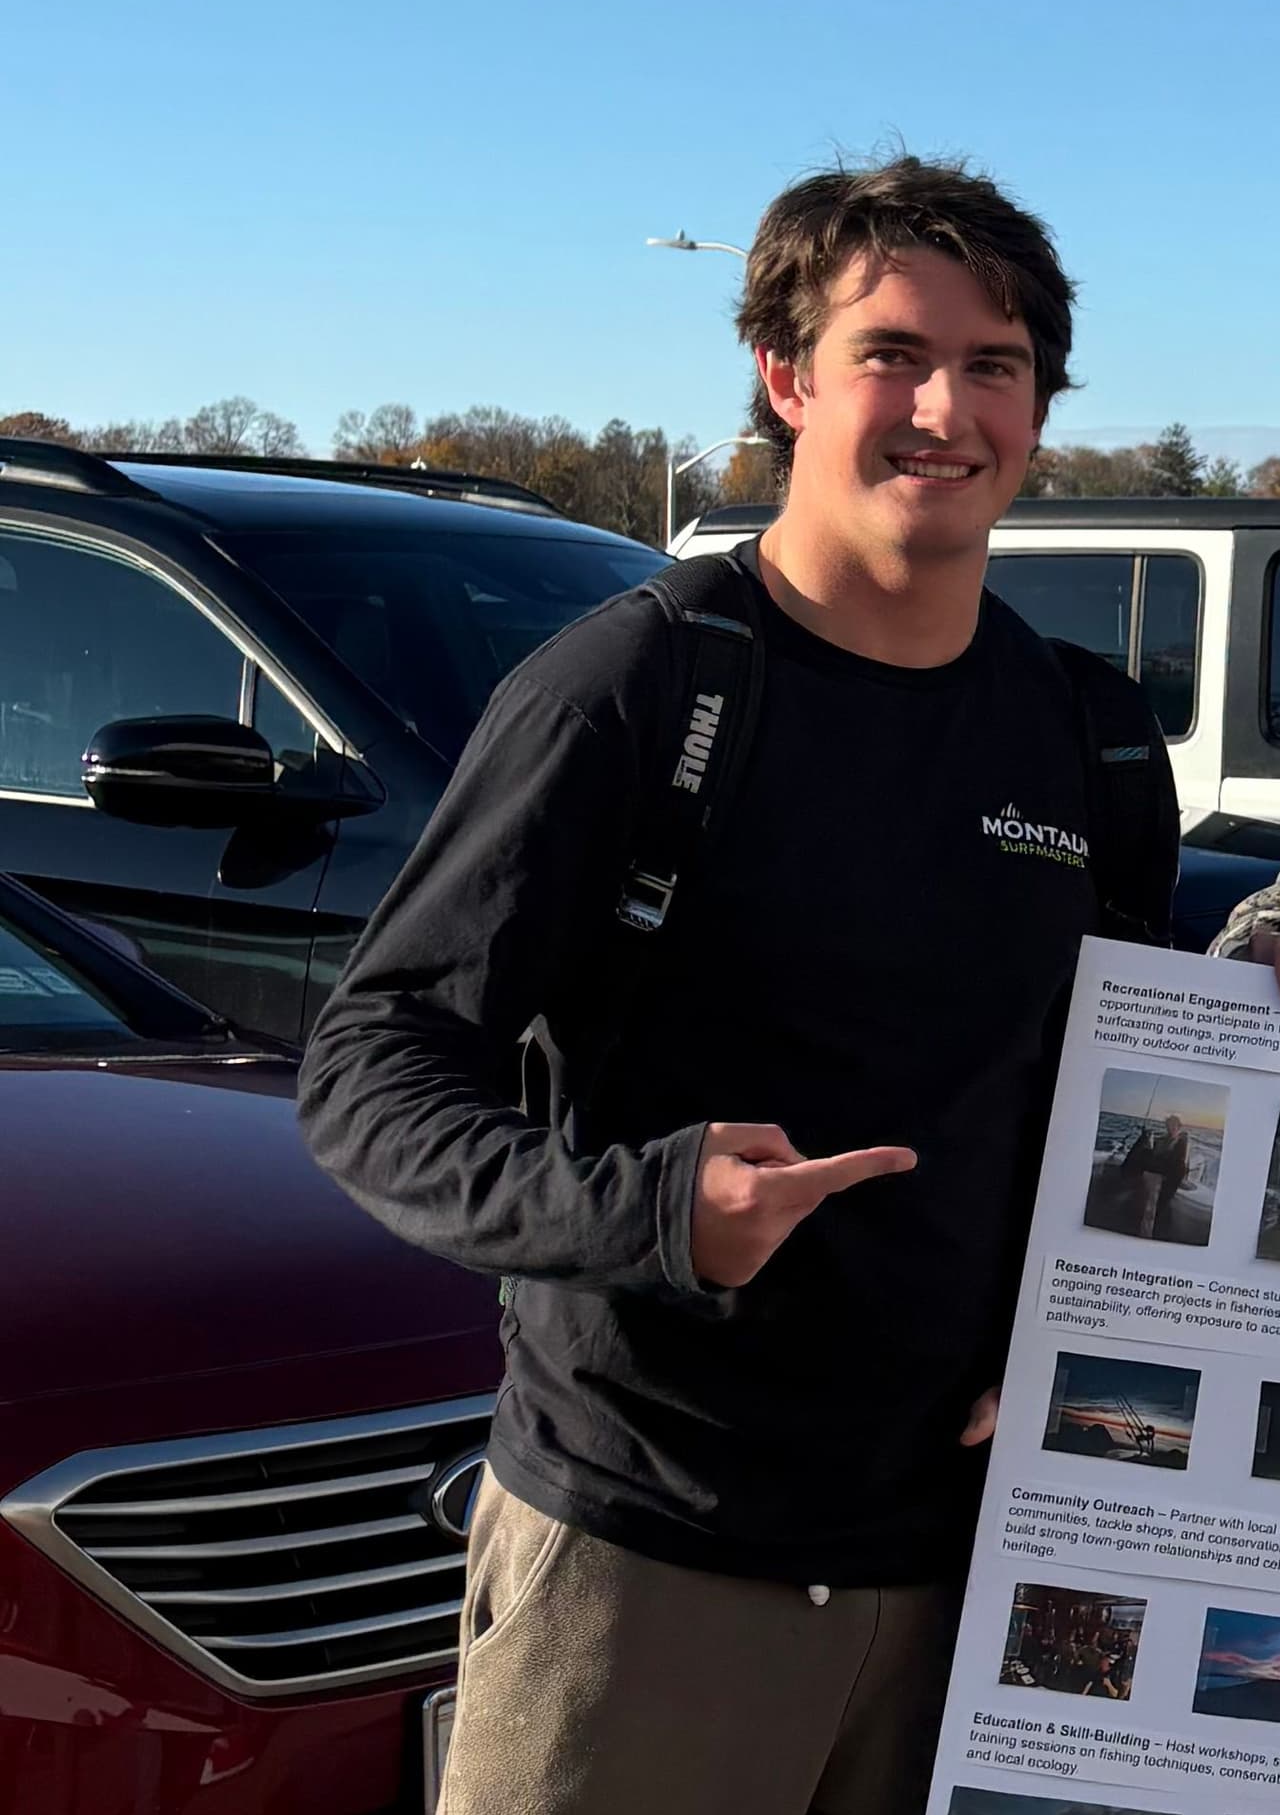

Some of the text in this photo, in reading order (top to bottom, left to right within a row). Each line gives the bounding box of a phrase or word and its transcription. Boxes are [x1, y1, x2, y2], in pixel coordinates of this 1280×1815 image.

[672, 693, 724, 794] THULE
[1102, 980, 1185, 1003] Recreational
[1188, 992, 1270, 1015] Engagement
[1051, 1277, 1102, 1296] ongoing
[1105, 1285, 1160, 1302] research
[1162, 1293, 1212, 1308] projects
[1215, 1298, 1227, 1310] in
[1054, 1258, 1118, 1279] Research
[1121, 1267, 1193, 1289] Integration
[1208, 1280, 1260, 1299] Connect
[1046, 1310, 1108, 1329] pathways.
[1049, 1294, 1131, 1317] sustainability,
[1135, 1304, 1182, 1324] offering
[1185, 1313, 1243, 1330] exposure
[1245, 1320, 1258, 1332] to
[1008, 1506, 1091, 1528] communities,
[1095, 1516, 1133, 1532] tackle
[1133, 1521, 1176, 1540] shops,
[1180, 1529, 1205, 1542] and
[1011, 1487, 1090, 1511] Community
[1092, 1498, 1155, 1518] Outreach
[1169, 1508, 1216, 1526] Partner
[1219, 1518, 1244, 1530] with
[1247, 1519, 1277, 1535] local
[1002, 1537, 1056, 1557] heritage.
[1004, 1520, 1037, 1536] build
[1038, 1526, 1079, 1545] strong
[1082, 1531, 1151, 1552] town-gown
[1153, 1542, 1233, 1564] relationships
[1235, 1554, 1260, 1567] and
[966, 1749, 992, 1761] and
[993, 1749, 1025, 1766] local
[969, 1729, 1017, 1750] training
[1018, 1738, 1077, 1756] sessions
[1078, 1746, 1096, 1758] on
[1098, 1746, 1141, 1767] fishing
[1143, 1754, 1215, 1776] techniques,
[973, 1711, 1042, 1733] Education
[1045, 1722, 1055, 1734] &
[1059, 1724, 1150, 1751] Skill-Building
[1165, 1739, 1195, 1755] Host
[1198, 1746, 1268, 1766] workshops,
